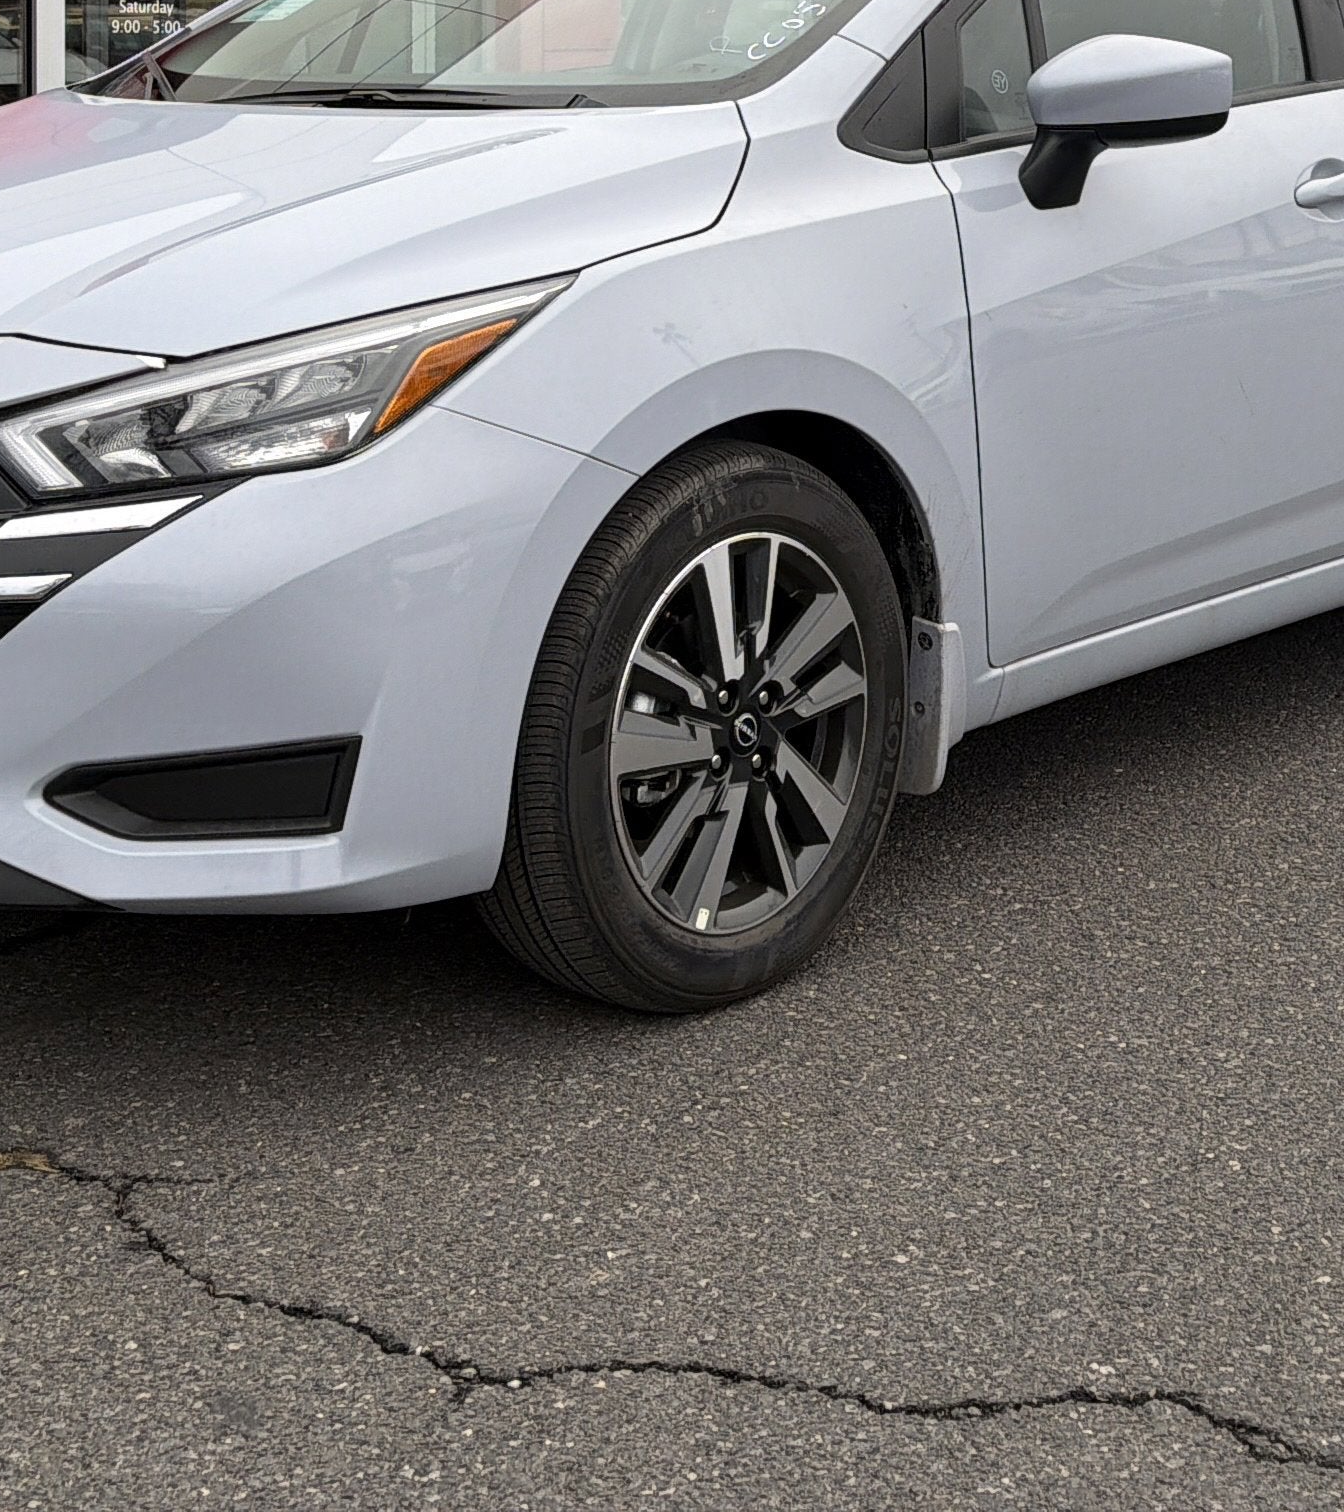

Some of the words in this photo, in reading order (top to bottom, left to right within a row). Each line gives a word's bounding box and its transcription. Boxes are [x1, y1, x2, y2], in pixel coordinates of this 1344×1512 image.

[118, 0, 174, 17] Saturday
[111, 19, 141, 34] 9:00
[152, 20, 181, 34] 5:00
